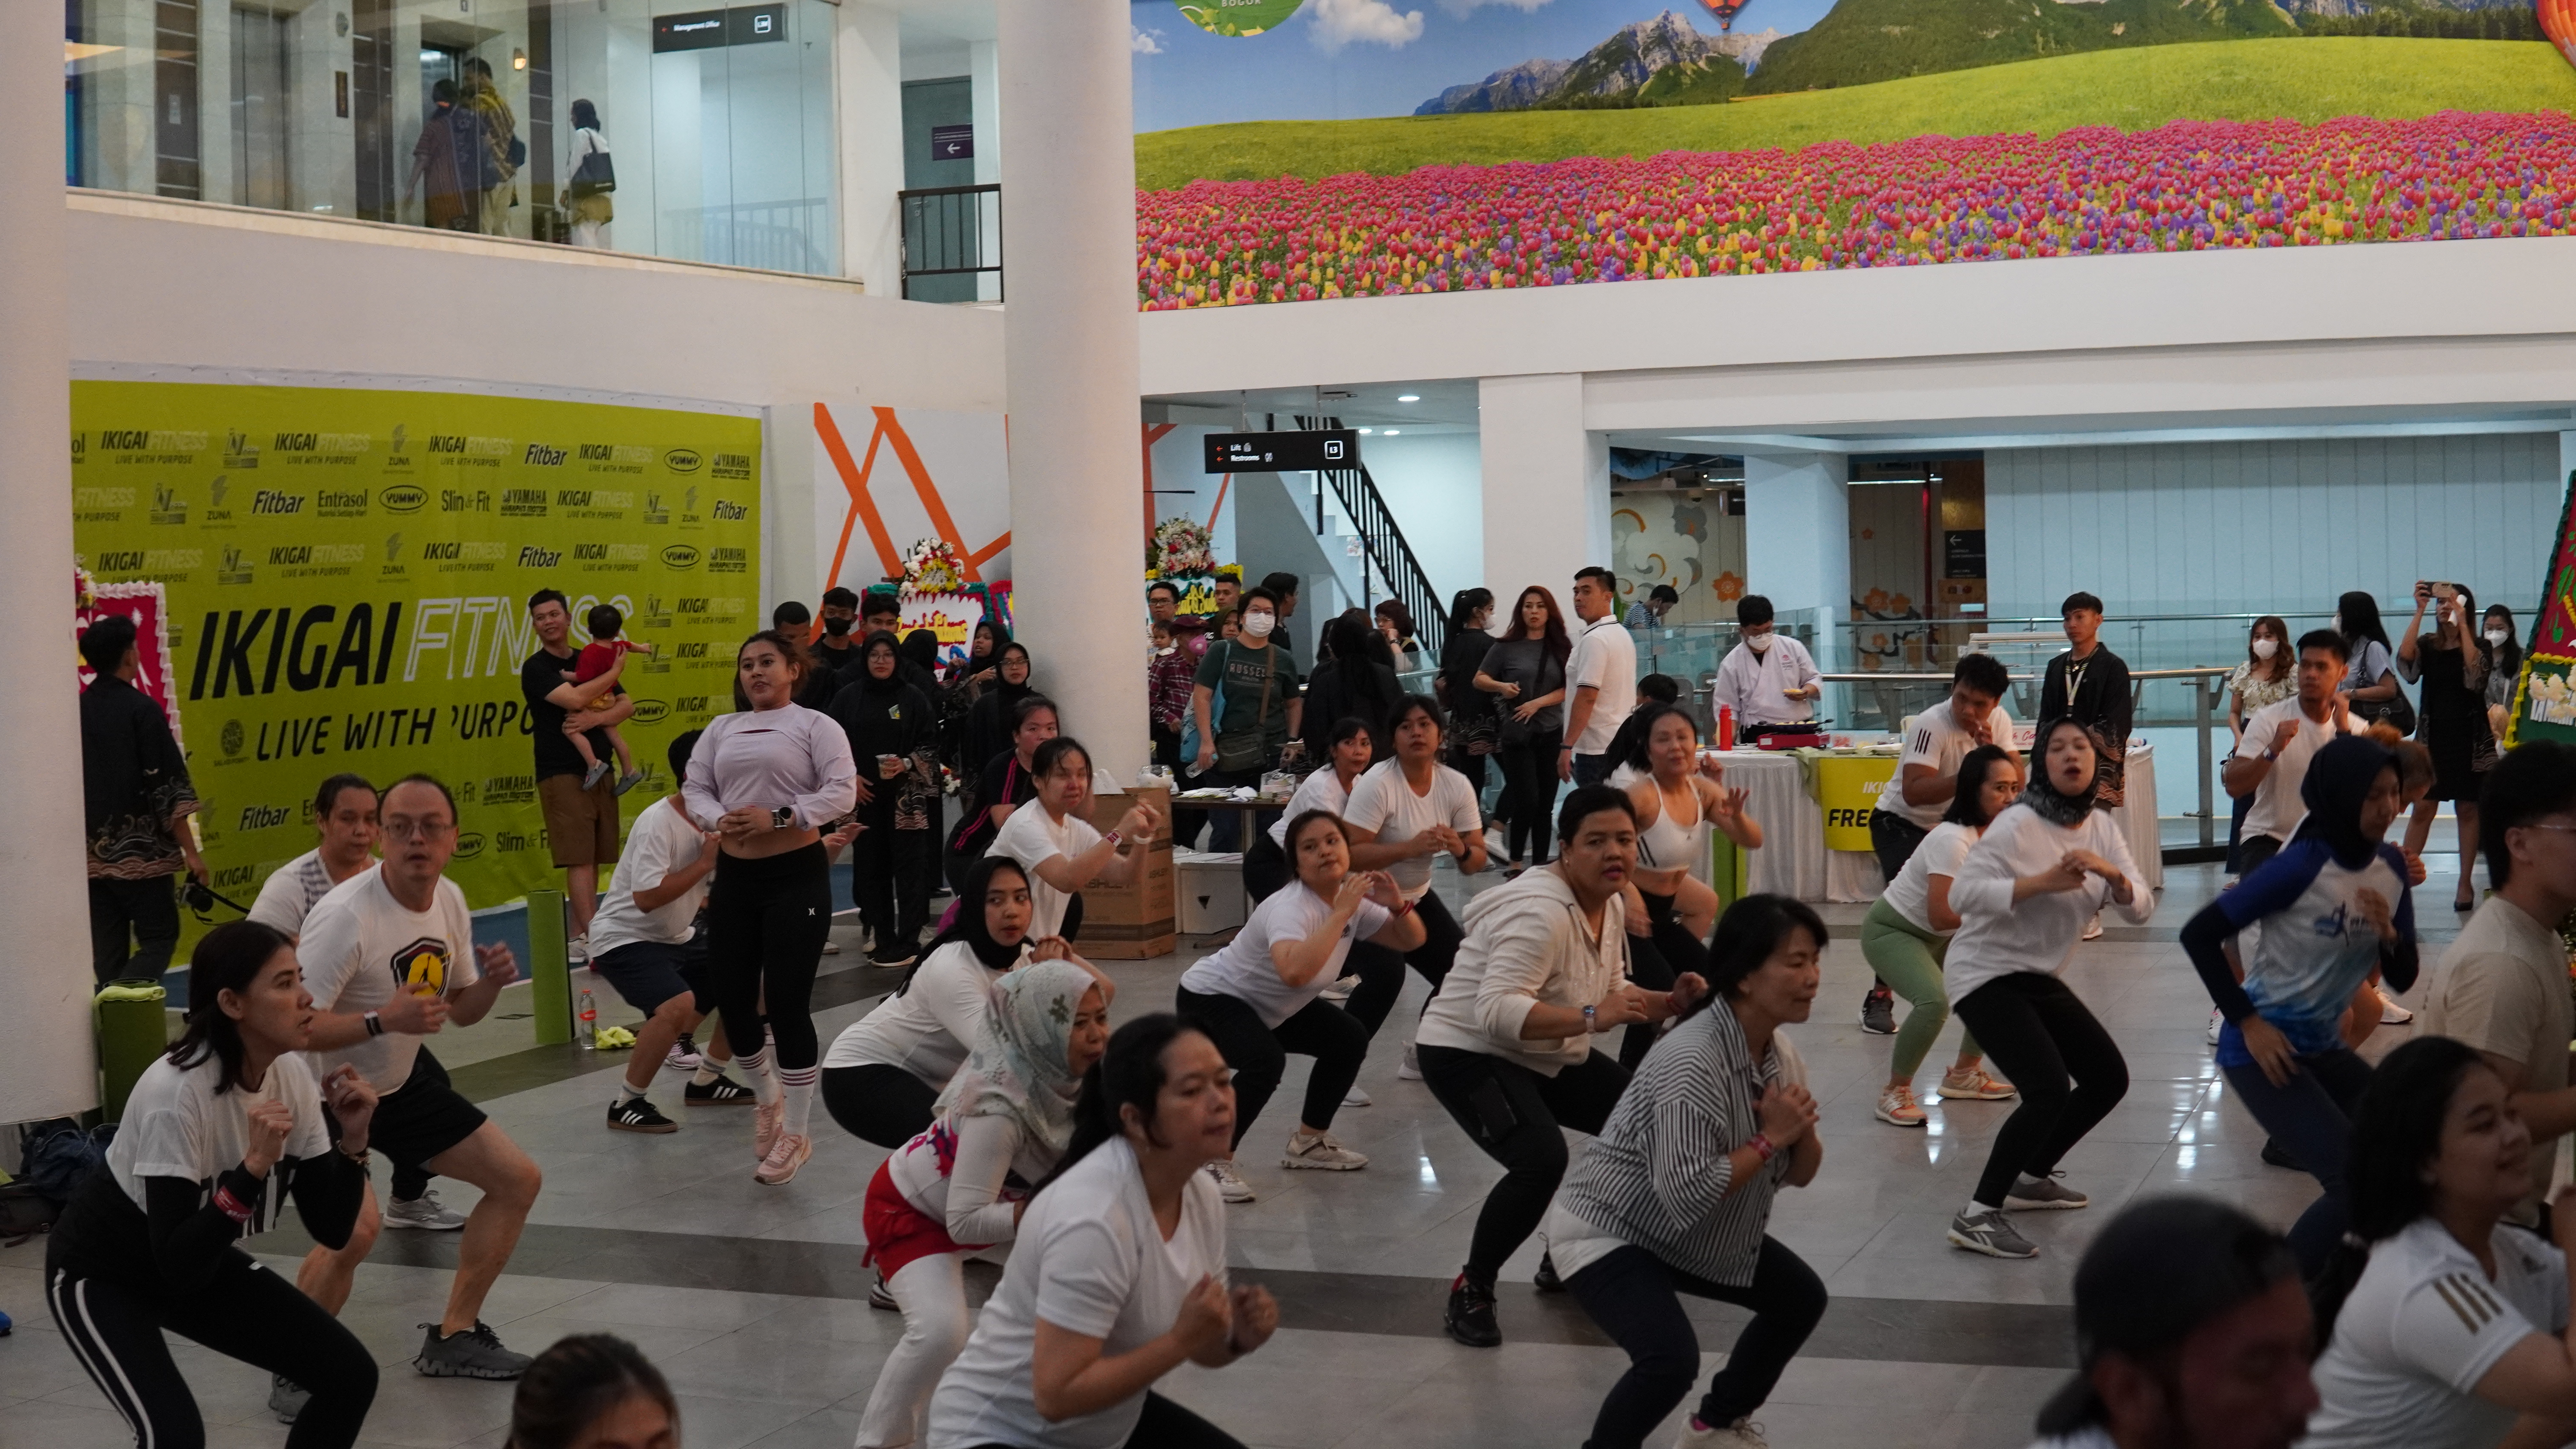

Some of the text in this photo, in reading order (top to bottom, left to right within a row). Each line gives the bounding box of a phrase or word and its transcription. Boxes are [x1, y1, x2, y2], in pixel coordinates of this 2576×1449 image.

[101, 430, 149, 449] IKIGAI
[275, 433, 317, 451] IKIGAI
[429, 436, 466, 453] IKIGAI
[524, 443, 568, 466] Fitbar
[579, 443, 613, 460] IKIGAI
[252, 490, 305, 514] Fitbar
[318, 489, 368, 507] Entrasol
[386, 493, 422, 504] YUMMY
[557, 490, 591, 506] IKIGAI
[713, 500, 748, 521] Fitbar
[98, 551, 144, 571] IKIGAI
[269, 546, 312, 565] IKIGAI
[517, 546, 562, 568] Fitbar
[574, 544, 607, 560] IKIGAI
[189, 602, 402, 701] IKIGAI
[257, 716, 332, 762] LIVE
[343, 707, 436, 752] WITH
[240, 804, 291, 831] Fitbar
[497, 831, 524, 853] Slim
[213, 865, 254, 888] IKIGAI
